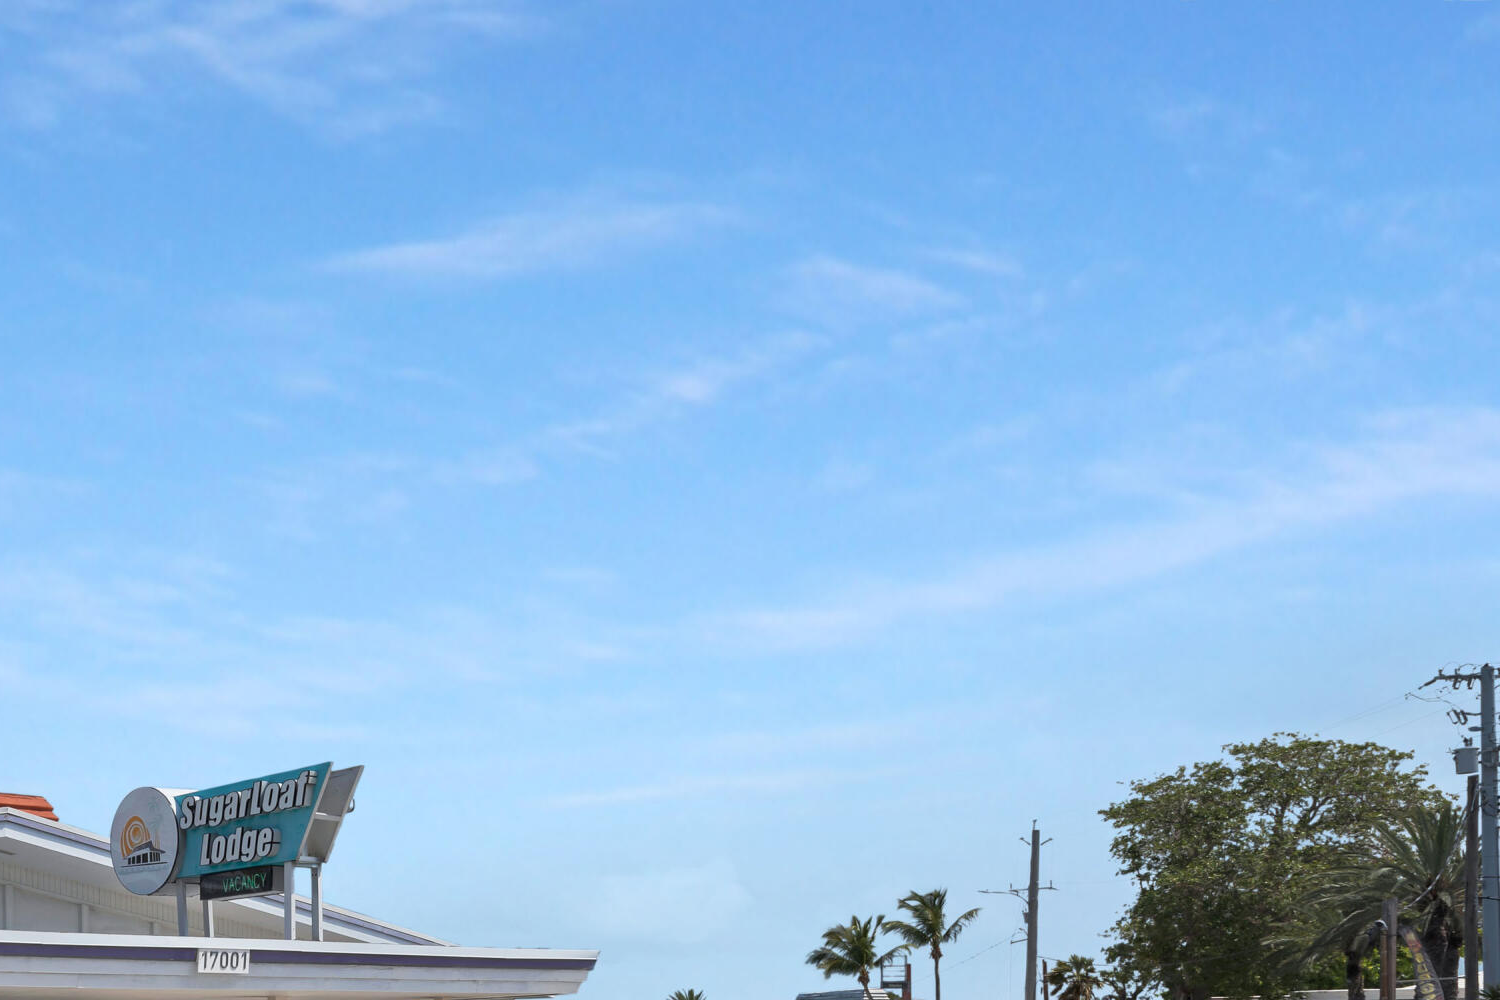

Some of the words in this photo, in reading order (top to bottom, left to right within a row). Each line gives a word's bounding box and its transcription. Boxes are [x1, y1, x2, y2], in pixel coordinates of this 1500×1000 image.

[179, 770, 316, 830] SugarLoaf
[200, 827, 277, 866] Lodge
[222, 872, 267, 893] VACANCY
[201, 951, 247, 971] 17001
